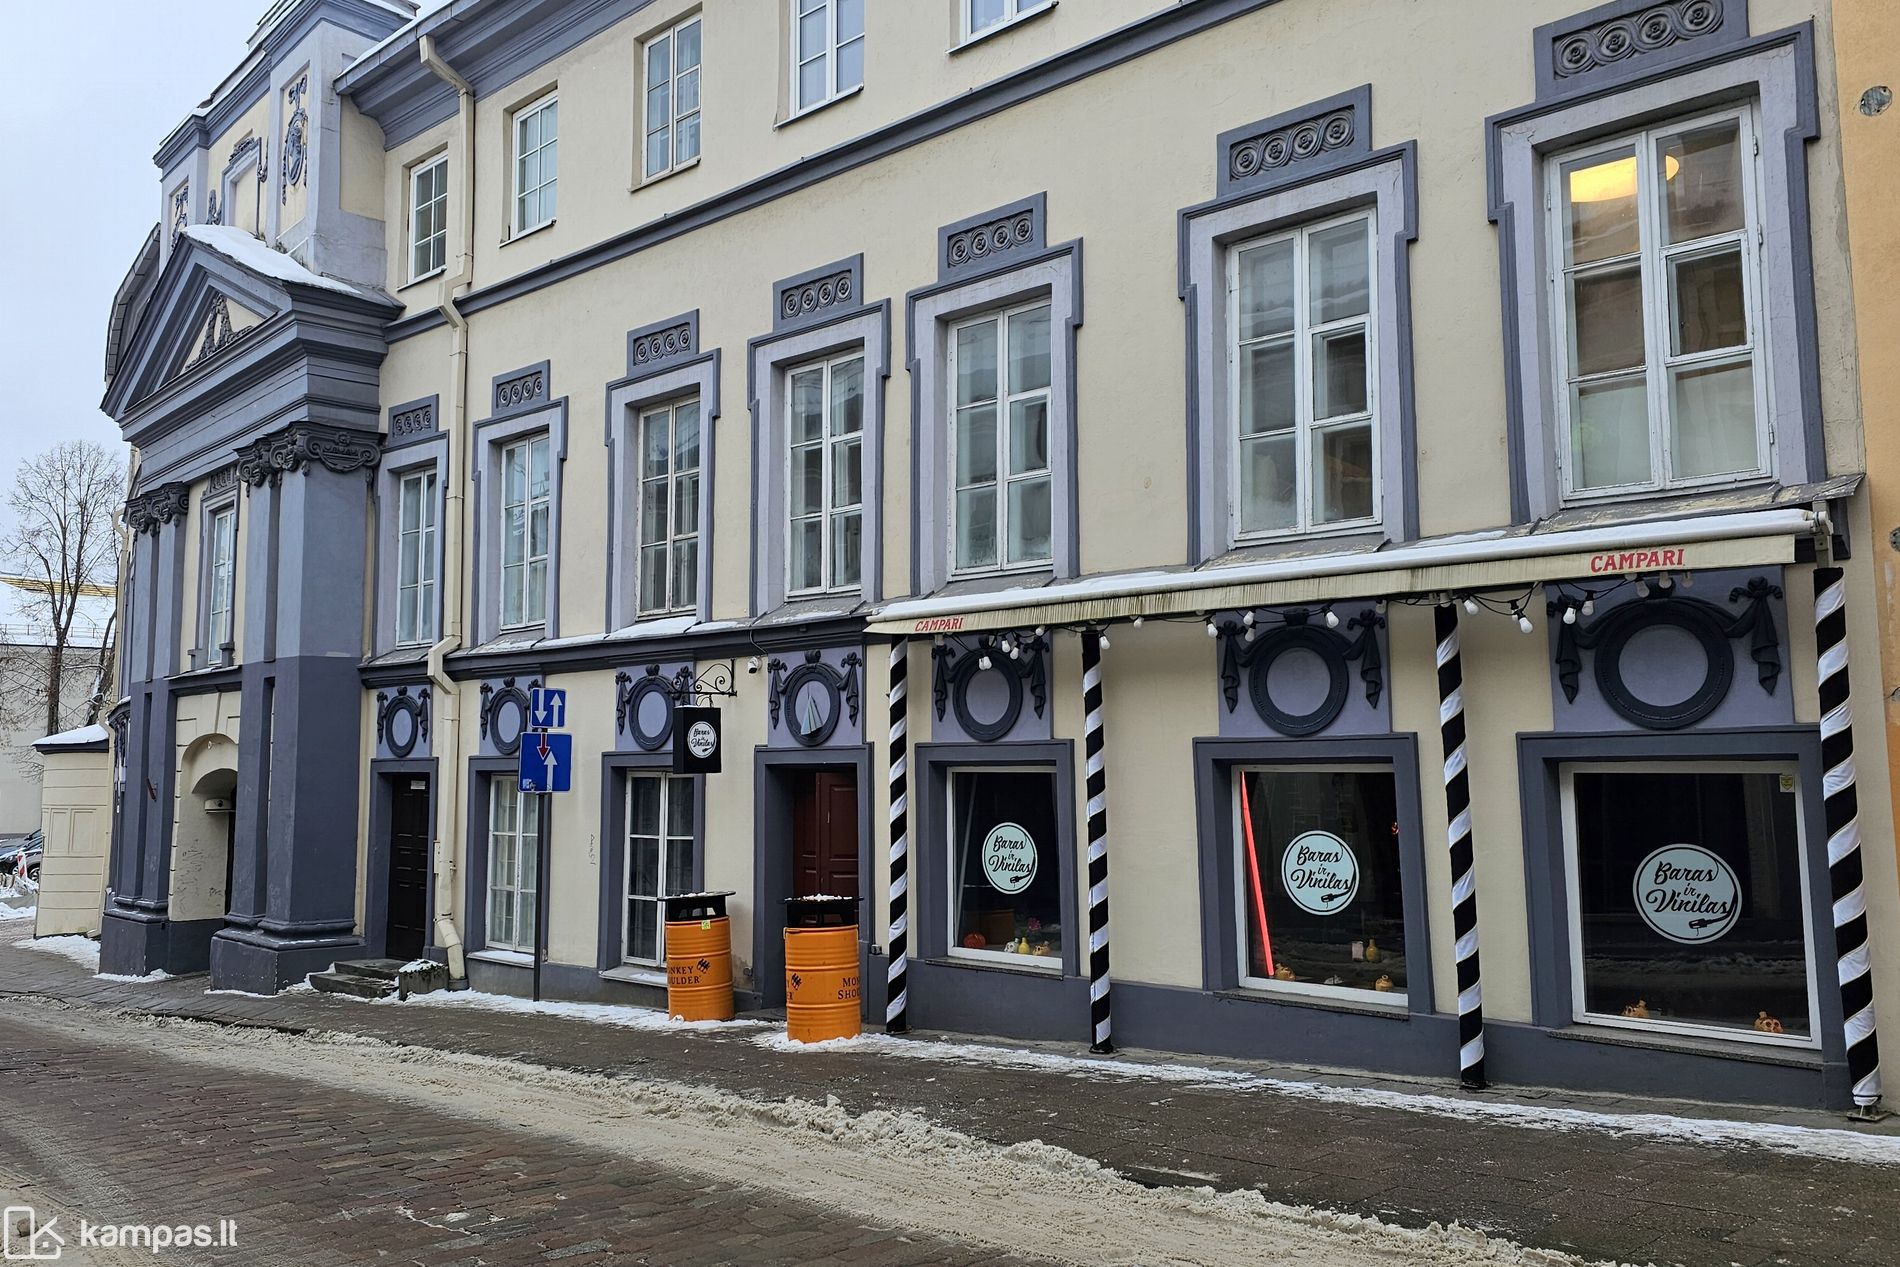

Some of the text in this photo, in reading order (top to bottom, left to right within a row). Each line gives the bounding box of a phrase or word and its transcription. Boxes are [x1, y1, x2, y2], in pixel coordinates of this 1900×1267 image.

[1591, 550, 1684, 573] CAMPARI
[915, 617, 963, 632] CAMPARI
[993, 834, 1026, 852] Baras
[988, 855, 1033, 873] Vinilas
[1297, 844, 1343, 866] Baras
[1316, 863, 1327, 875] ir
[1654, 860, 1718, 885] Baras
[1290, 868, 1352, 890] Vinilas
[1683, 882, 1696, 896] ir
[1645, 888, 1730, 914] Vinilas
[670, 965, 693, 975] NKEY
